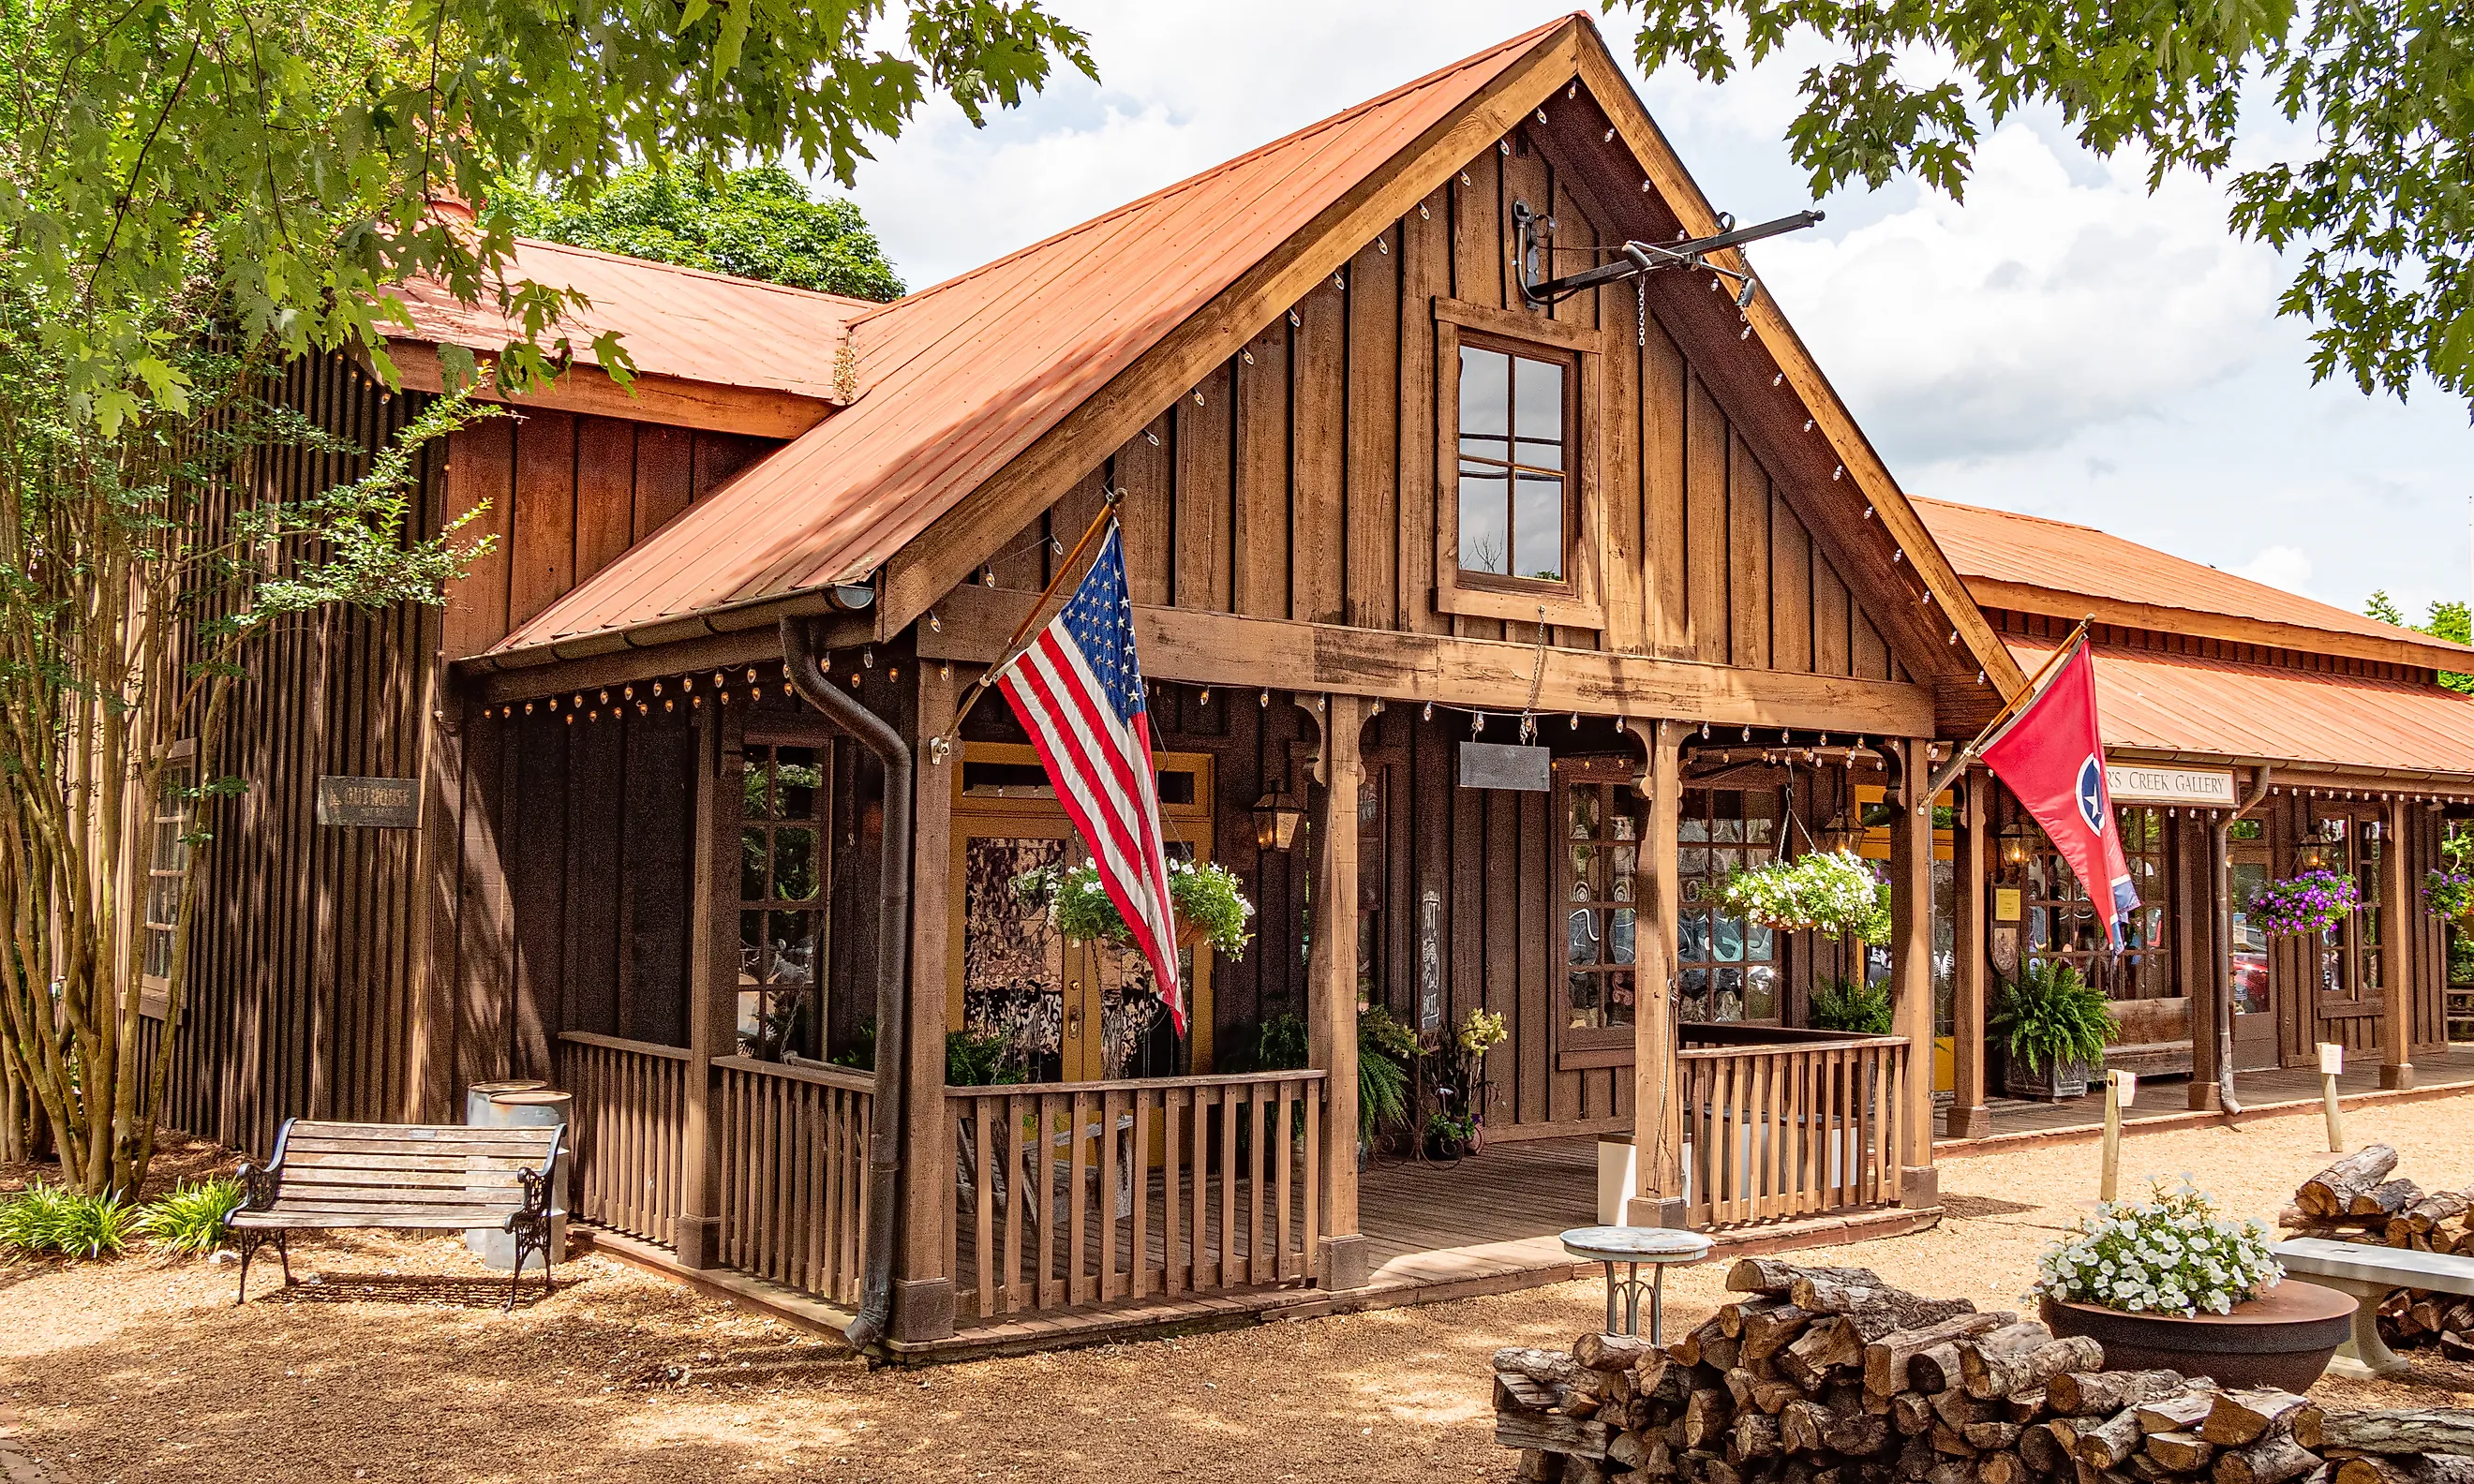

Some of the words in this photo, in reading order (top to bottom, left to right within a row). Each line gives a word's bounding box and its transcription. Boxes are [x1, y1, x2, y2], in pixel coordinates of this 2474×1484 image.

[2128, 771, 2170, 792] CREEK
[2175, 774, 2225, 794] GALLERY
[1423, 901, 1438, 930] ART
